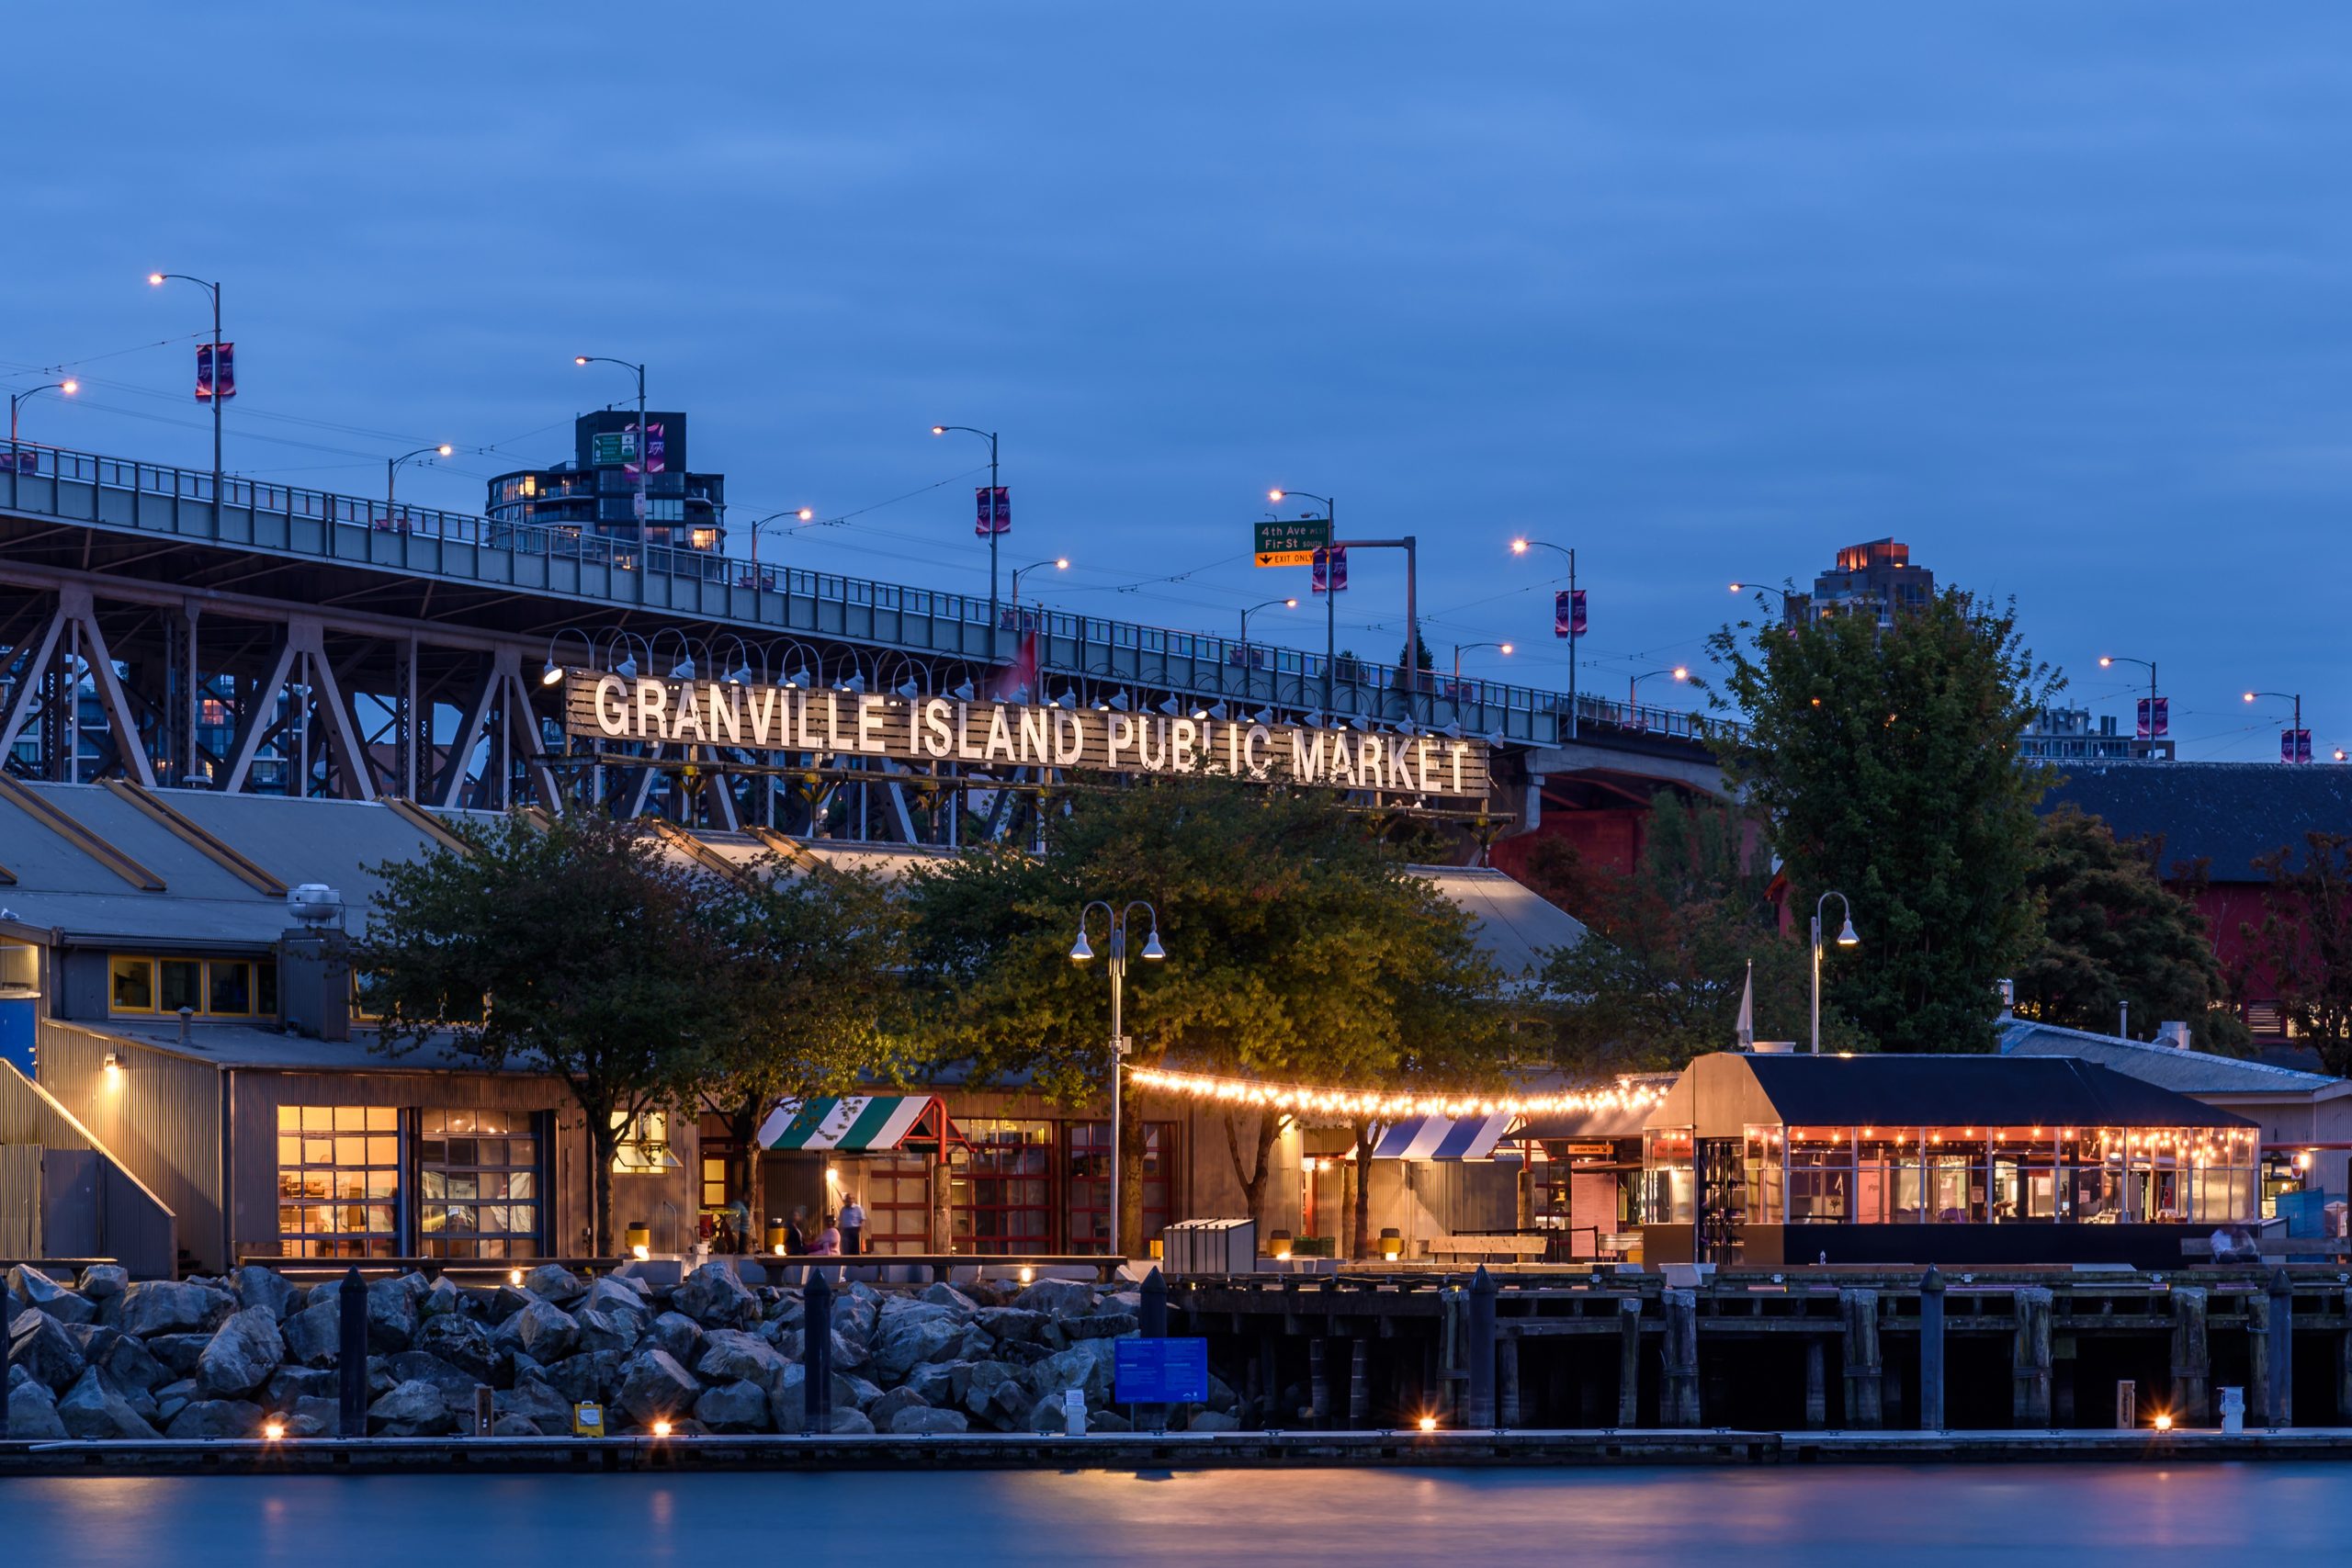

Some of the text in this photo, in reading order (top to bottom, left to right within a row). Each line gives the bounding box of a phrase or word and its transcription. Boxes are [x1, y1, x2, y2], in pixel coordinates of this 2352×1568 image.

[1261, 526, 1283, 536] 4th
[1286, 525, 1306, 536] Ave
[1285, 538, 1298, 548] St
[1274, 554, 1314, 563] EXIT ONLY
[594, 674, 1469, 794] GRANVILLE ISLAND PUBLIC MARKET
